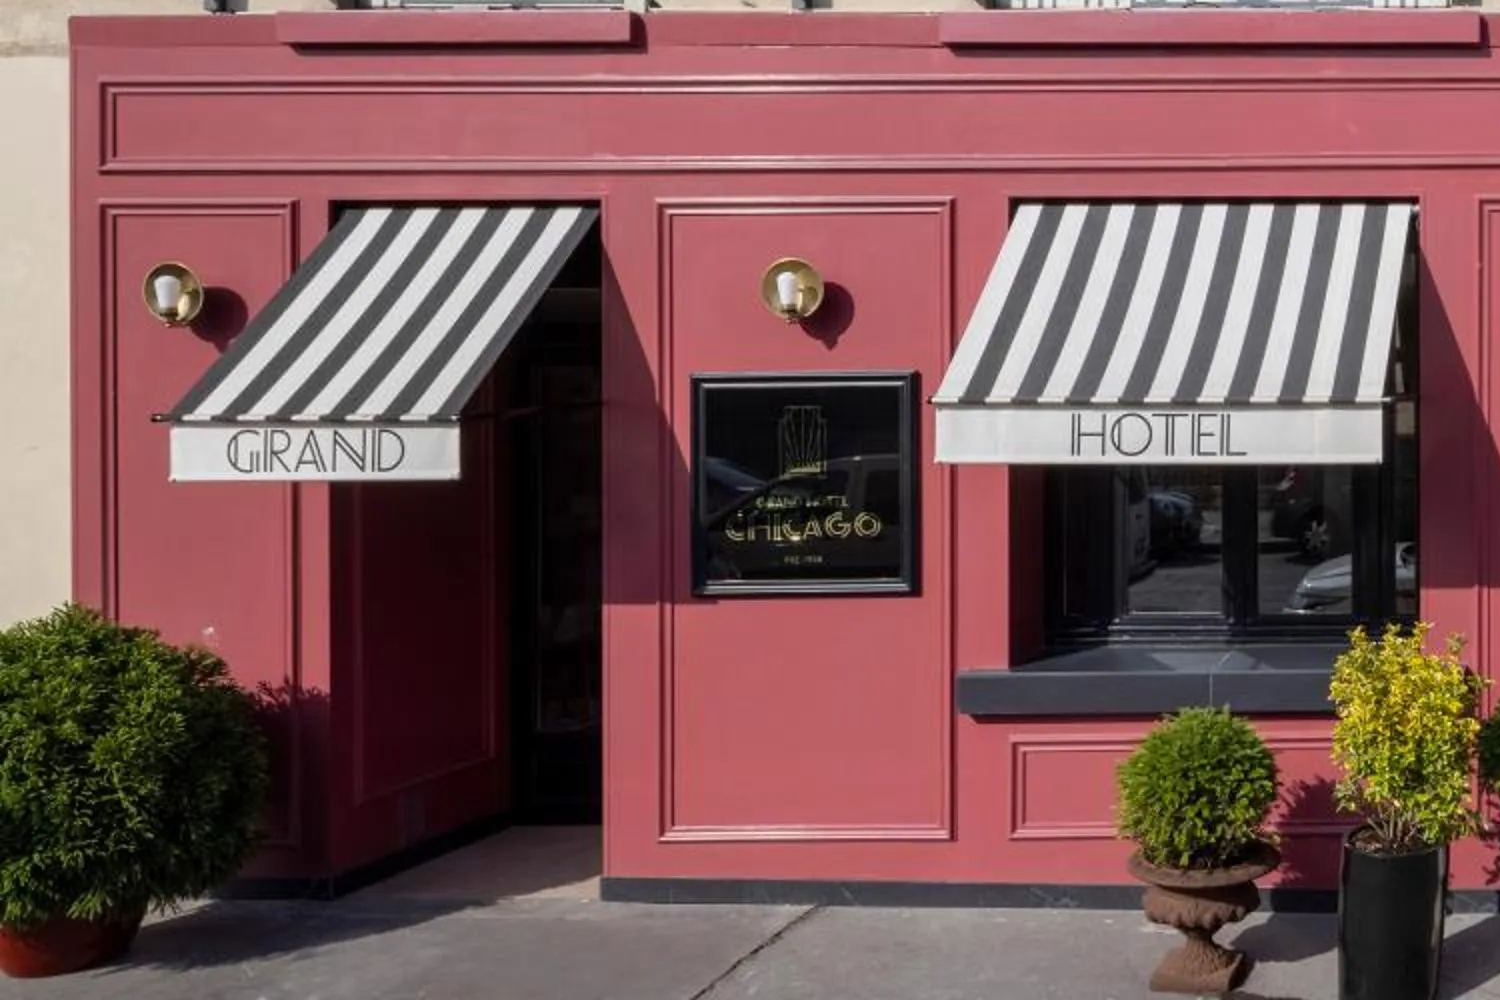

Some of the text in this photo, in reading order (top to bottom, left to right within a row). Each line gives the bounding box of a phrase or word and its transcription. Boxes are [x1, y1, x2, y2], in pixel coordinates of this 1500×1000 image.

[227, 428, 405, 473] GRAND
[1071, 412, 1248, 456] HOTEL
[725, 510, 881, 541] CHICAGO
